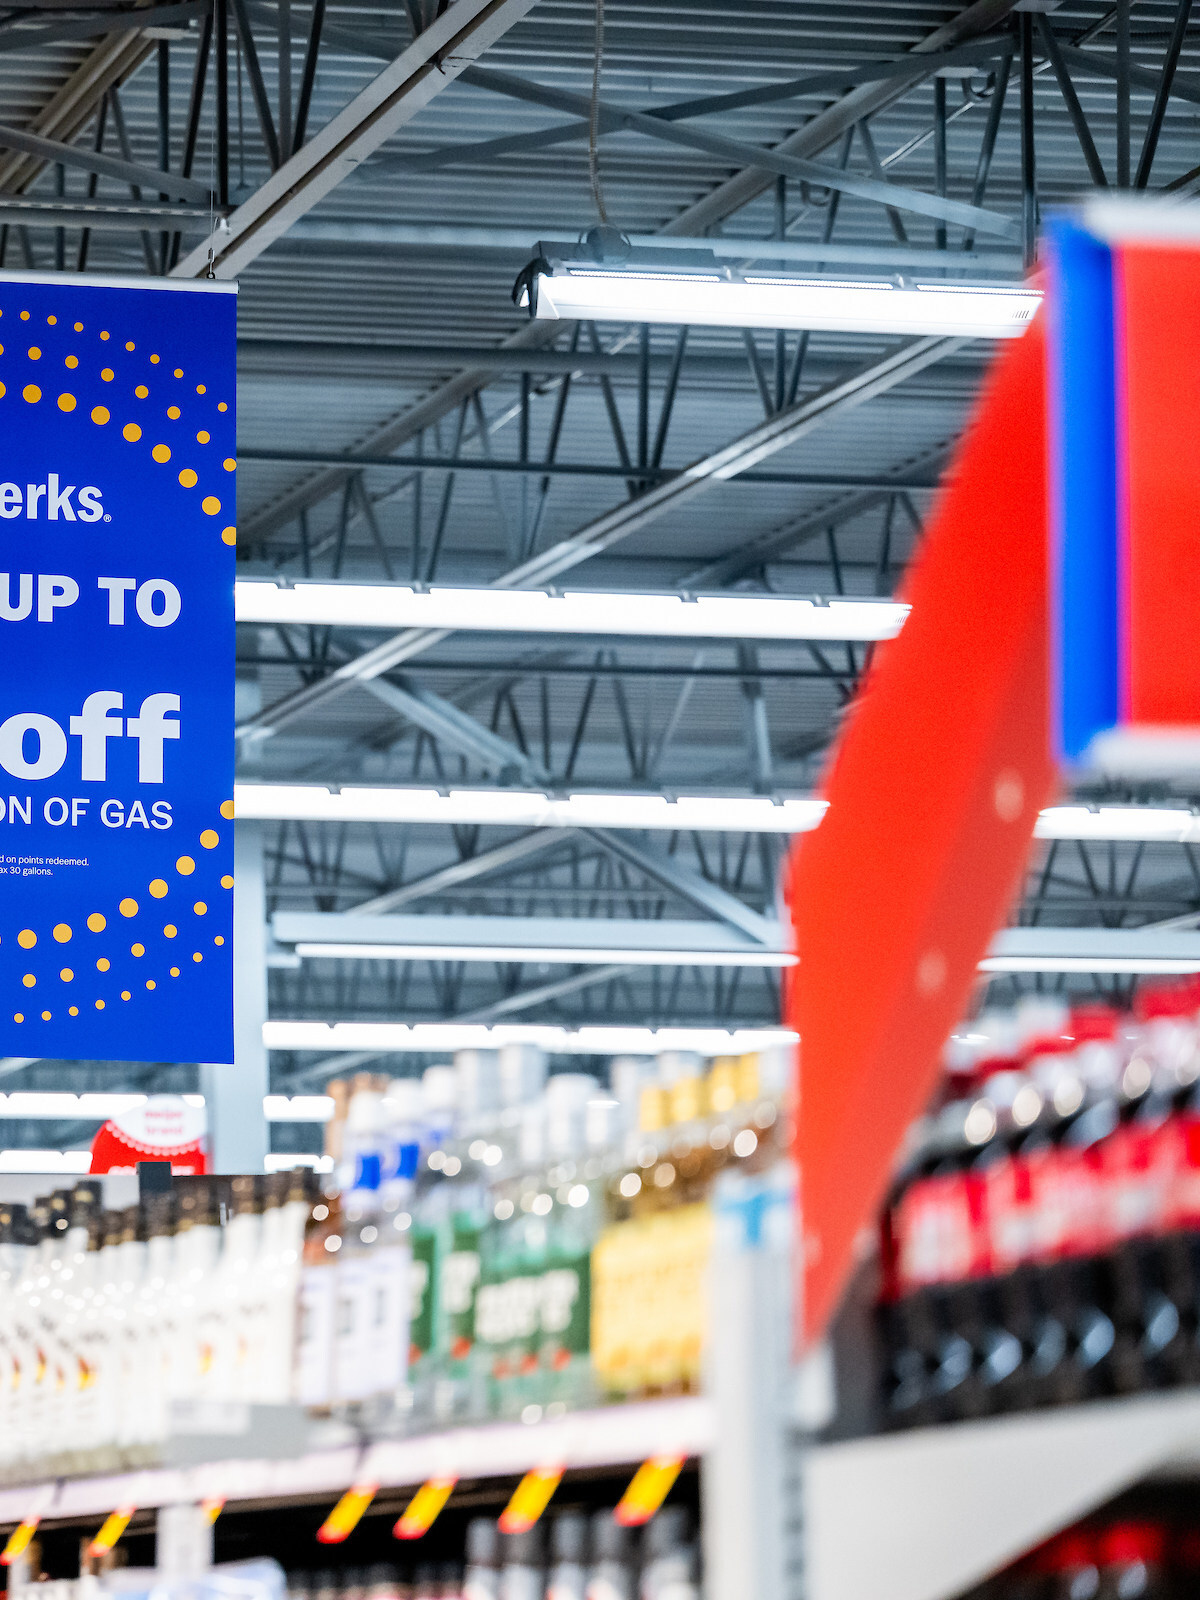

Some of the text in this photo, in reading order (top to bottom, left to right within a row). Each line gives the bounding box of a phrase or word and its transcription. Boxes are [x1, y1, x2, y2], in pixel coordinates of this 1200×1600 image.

[98, 577, 182, 628] TO
[43, 796, 91, 827] OF
[101, 798, 173, 830] GAS
[6, 856, 17, 864] on
[18, 856, 44, 866] points
[45, 857, 89, 866] redeemed.
[9, 866, 21, 875] 30
[22, 866, 54, 876] gallons.
